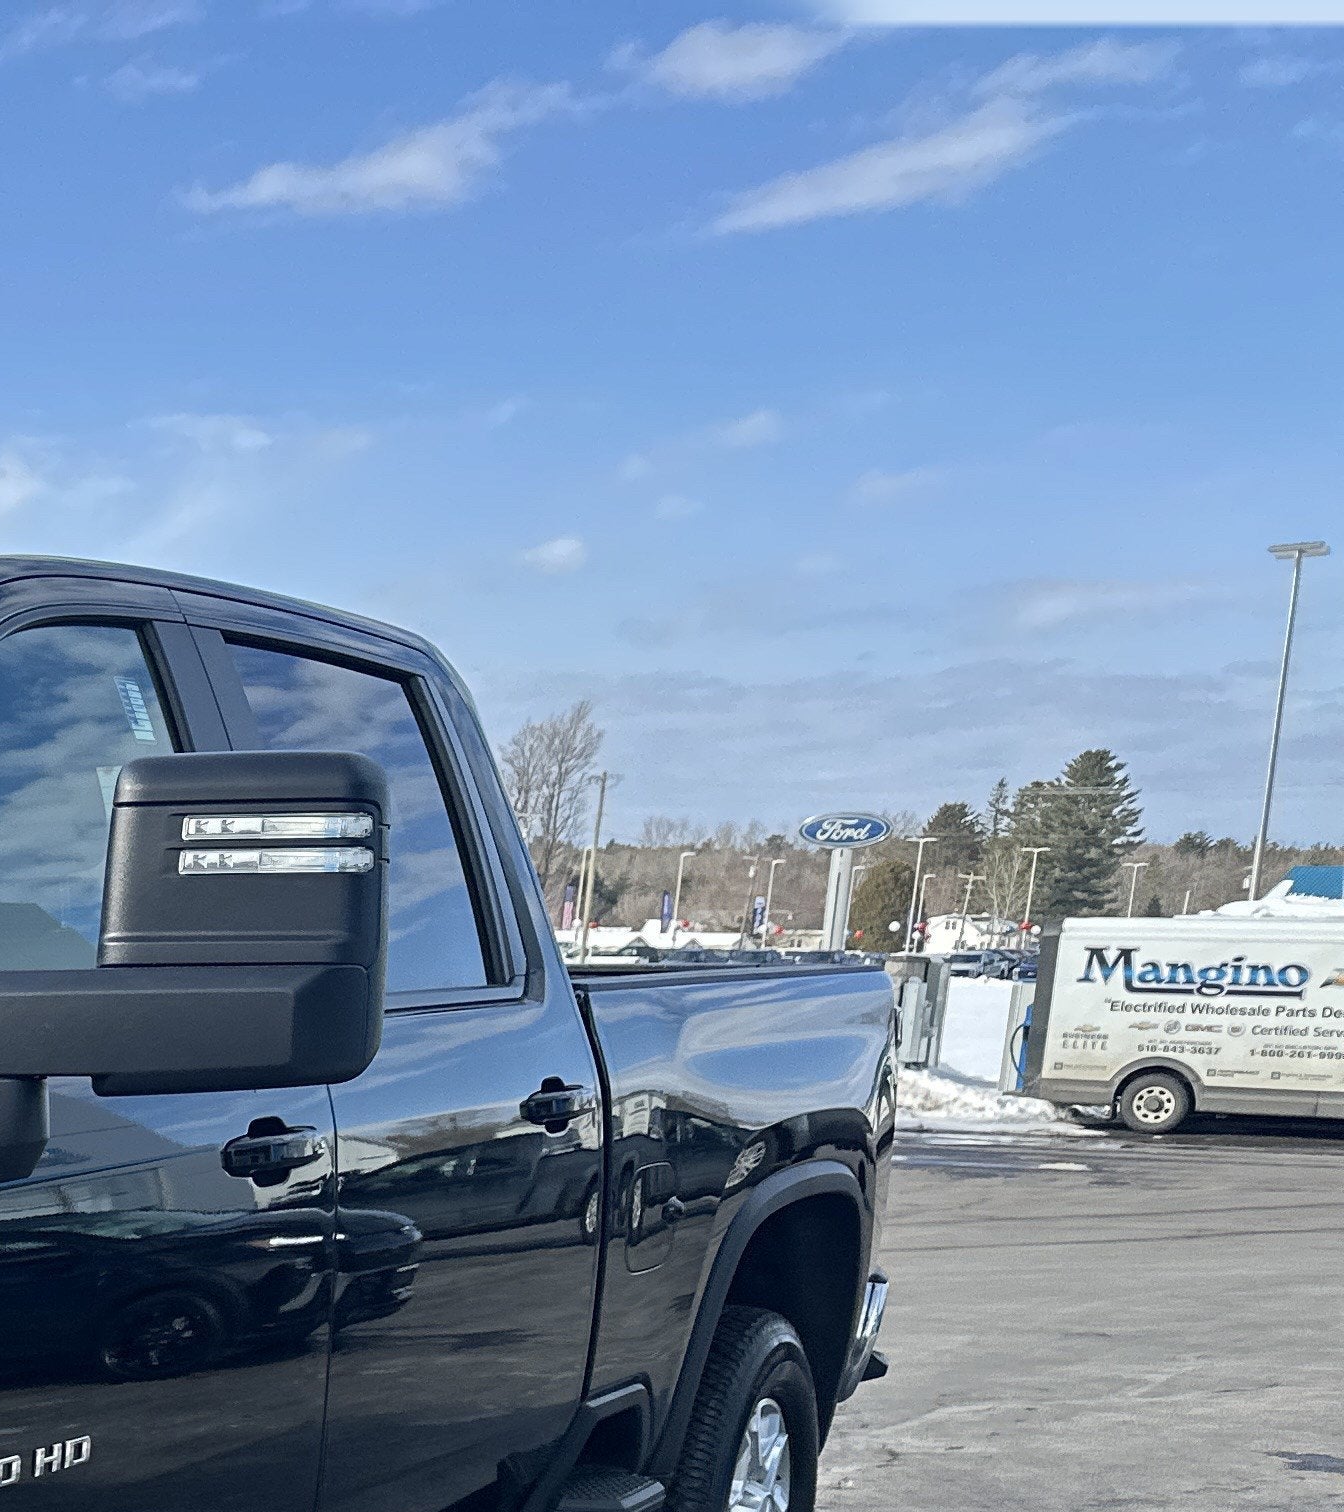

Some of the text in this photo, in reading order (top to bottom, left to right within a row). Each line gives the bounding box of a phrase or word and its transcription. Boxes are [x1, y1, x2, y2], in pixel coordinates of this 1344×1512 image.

[815, 819, 872, 841] Ford
[1076, 945, 1309, 1000] Mangino
[1191, 1002, 1271, 1017] Wholesale
[1275, 1005, 1317, 1018] Parts
[1321, 1006, 1344, 1019] De
[1251, 1025, 1310, 1037] Certified
[33, 1434, 92, 1478] HD
